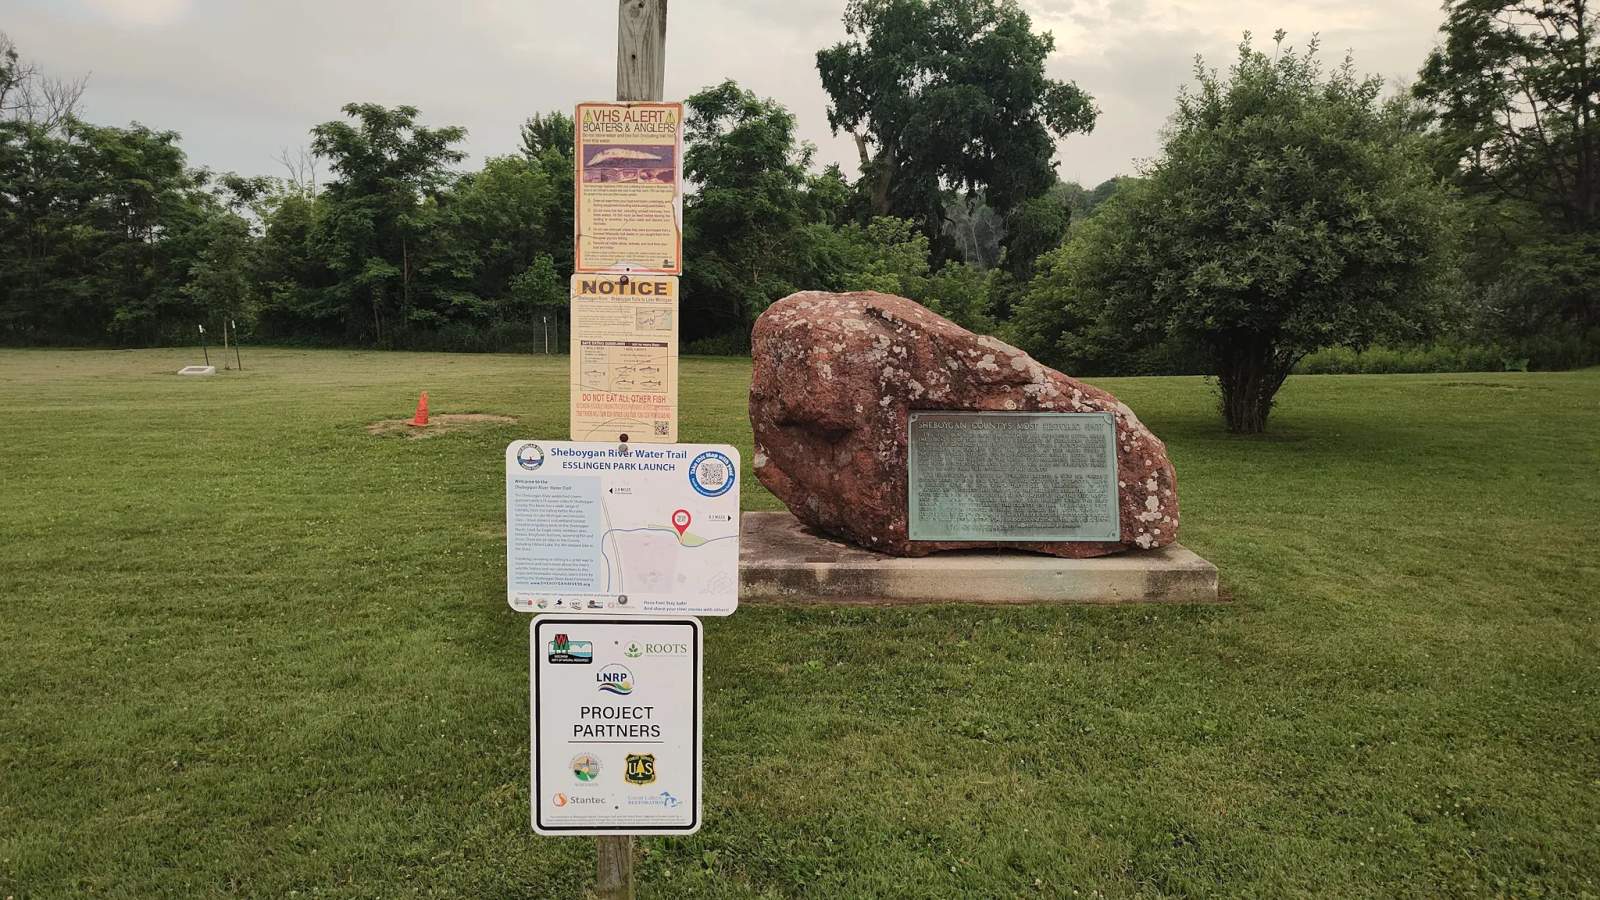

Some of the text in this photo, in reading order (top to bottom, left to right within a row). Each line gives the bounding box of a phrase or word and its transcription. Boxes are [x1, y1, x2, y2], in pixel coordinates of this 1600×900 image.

[593, 109, 665, 122] VHS ALERT
[583, 122, 676, 132] BOATERS & ANGLERS
[582, 280, 668, 296] NOTICE
[583, 393, 666, 404] DO NOT EAT ALL OTHER FISH
[919, 421, 967, 429] SHEBOYGAN
[551, 447, 606, 459] Sheboygan
[608, 449, 634, 458] River
[635, 449, 664, 459] Water
[666, 450, 687, 459] Trail
[562, 461, 676, 471] ESSLINGEN PARK LAUNCH
[646, 643, 687, 654] ROOTS
[596, 672, 627, 682] LNRP
[580, 706, 654, 719] PROJECT
[573, 724, 661, 738] PARTNERS
[570, 796, 606, 805] Stantec
